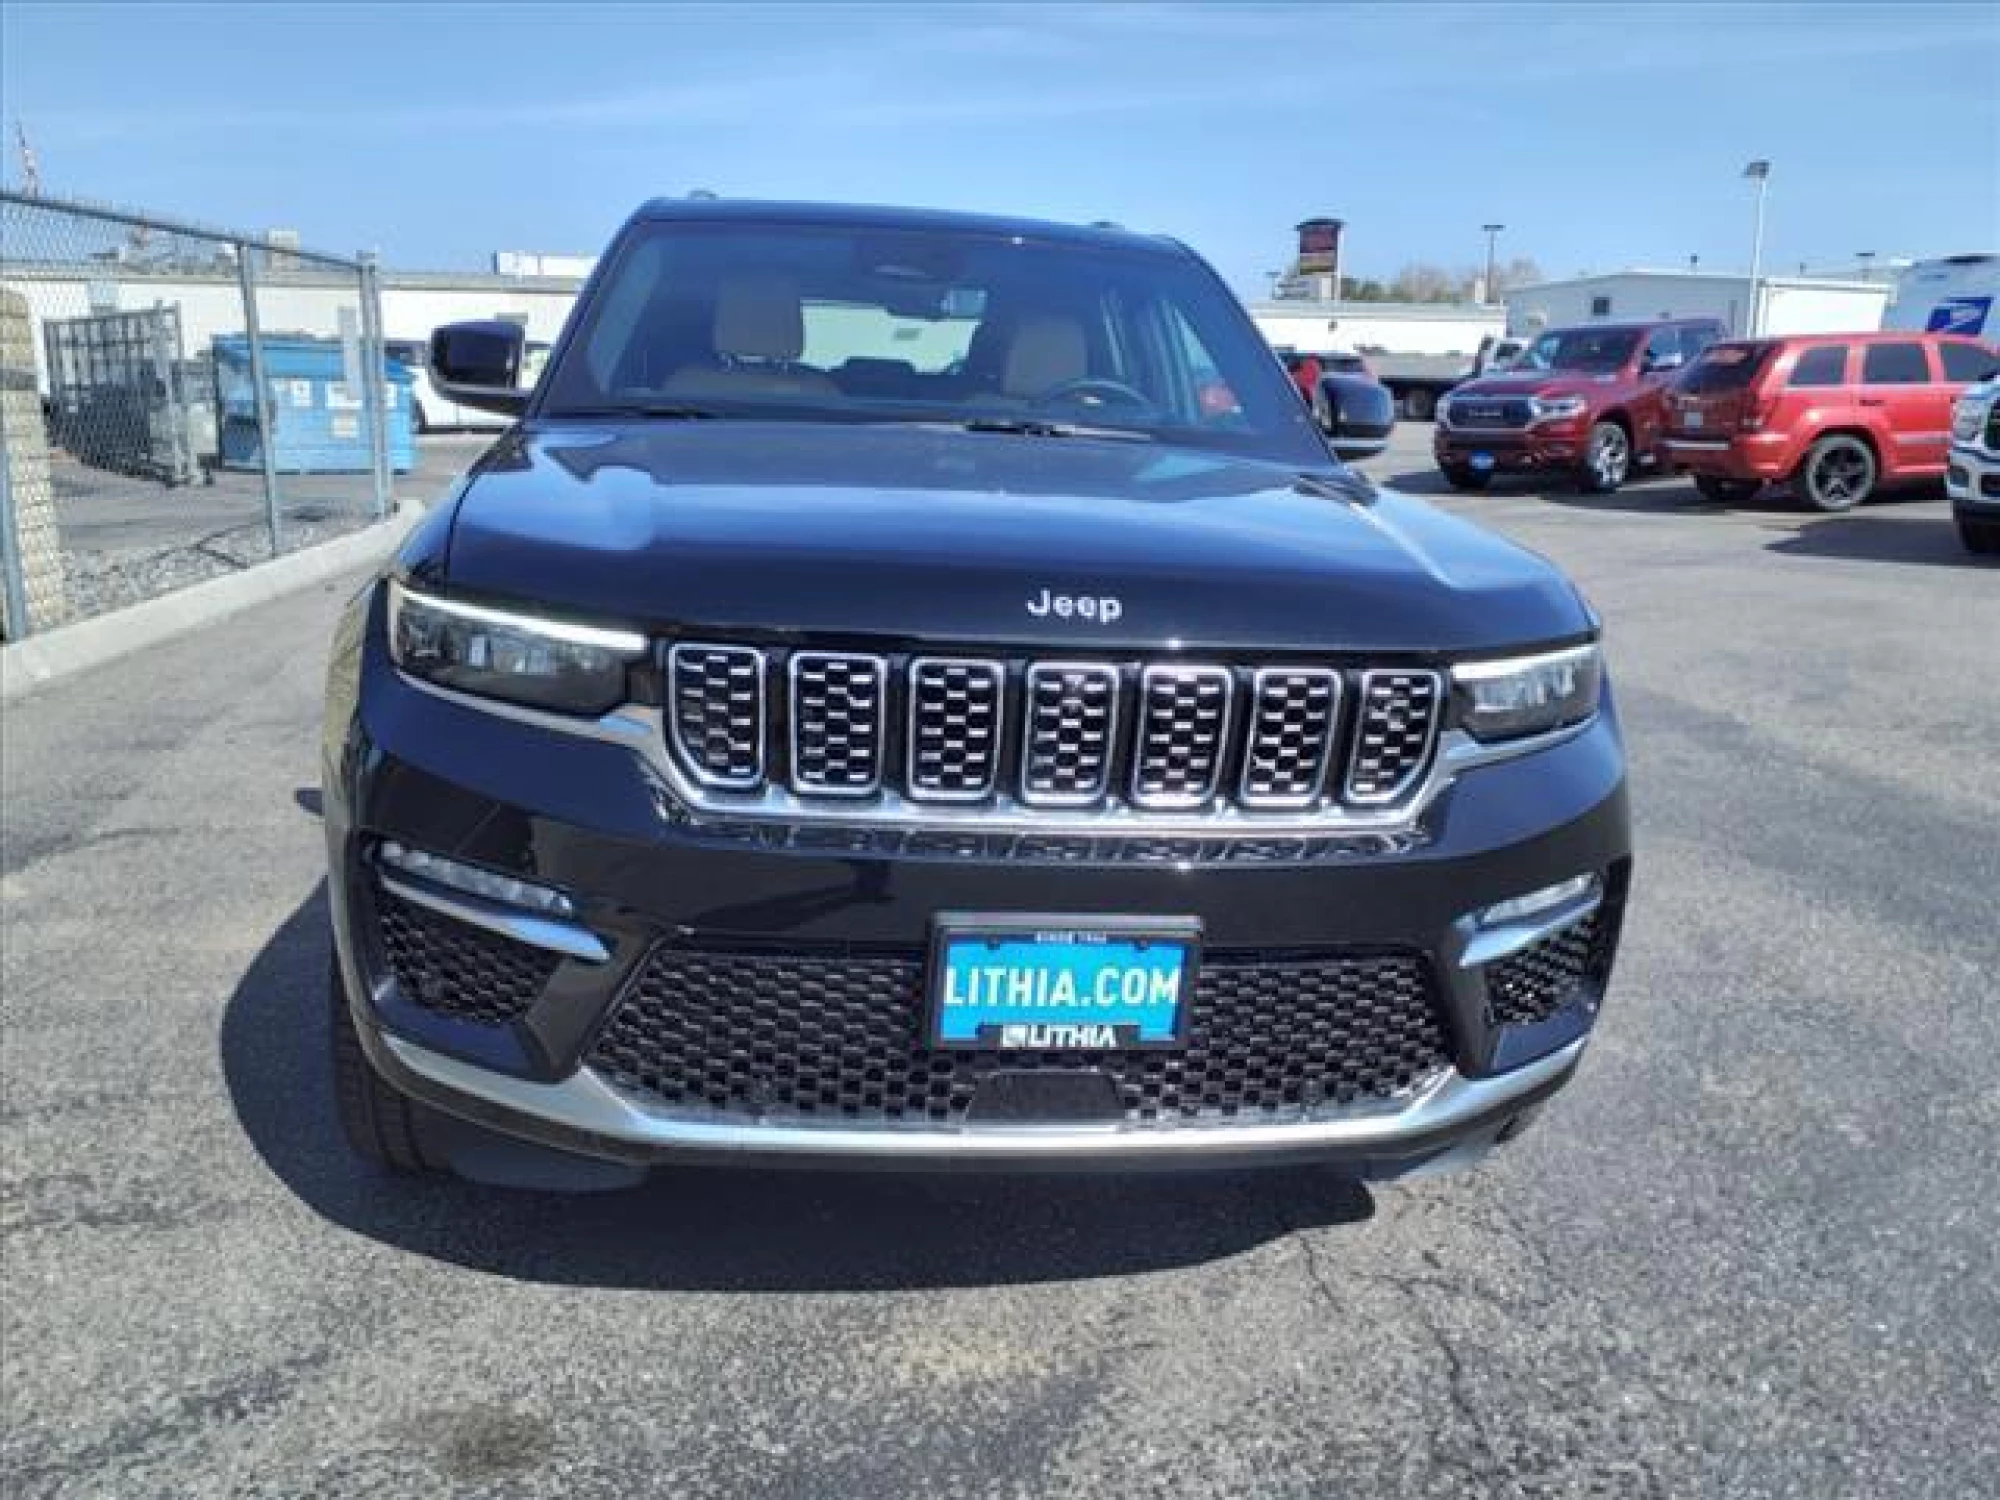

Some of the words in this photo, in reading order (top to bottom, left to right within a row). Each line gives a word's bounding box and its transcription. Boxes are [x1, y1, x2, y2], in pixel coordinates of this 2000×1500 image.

[1026, 587, 1122, 624] Jeep
[944, 967, 1180, 1007] LITHIA.COM
[1030, 1024, 1116, 1048] LITHIA
